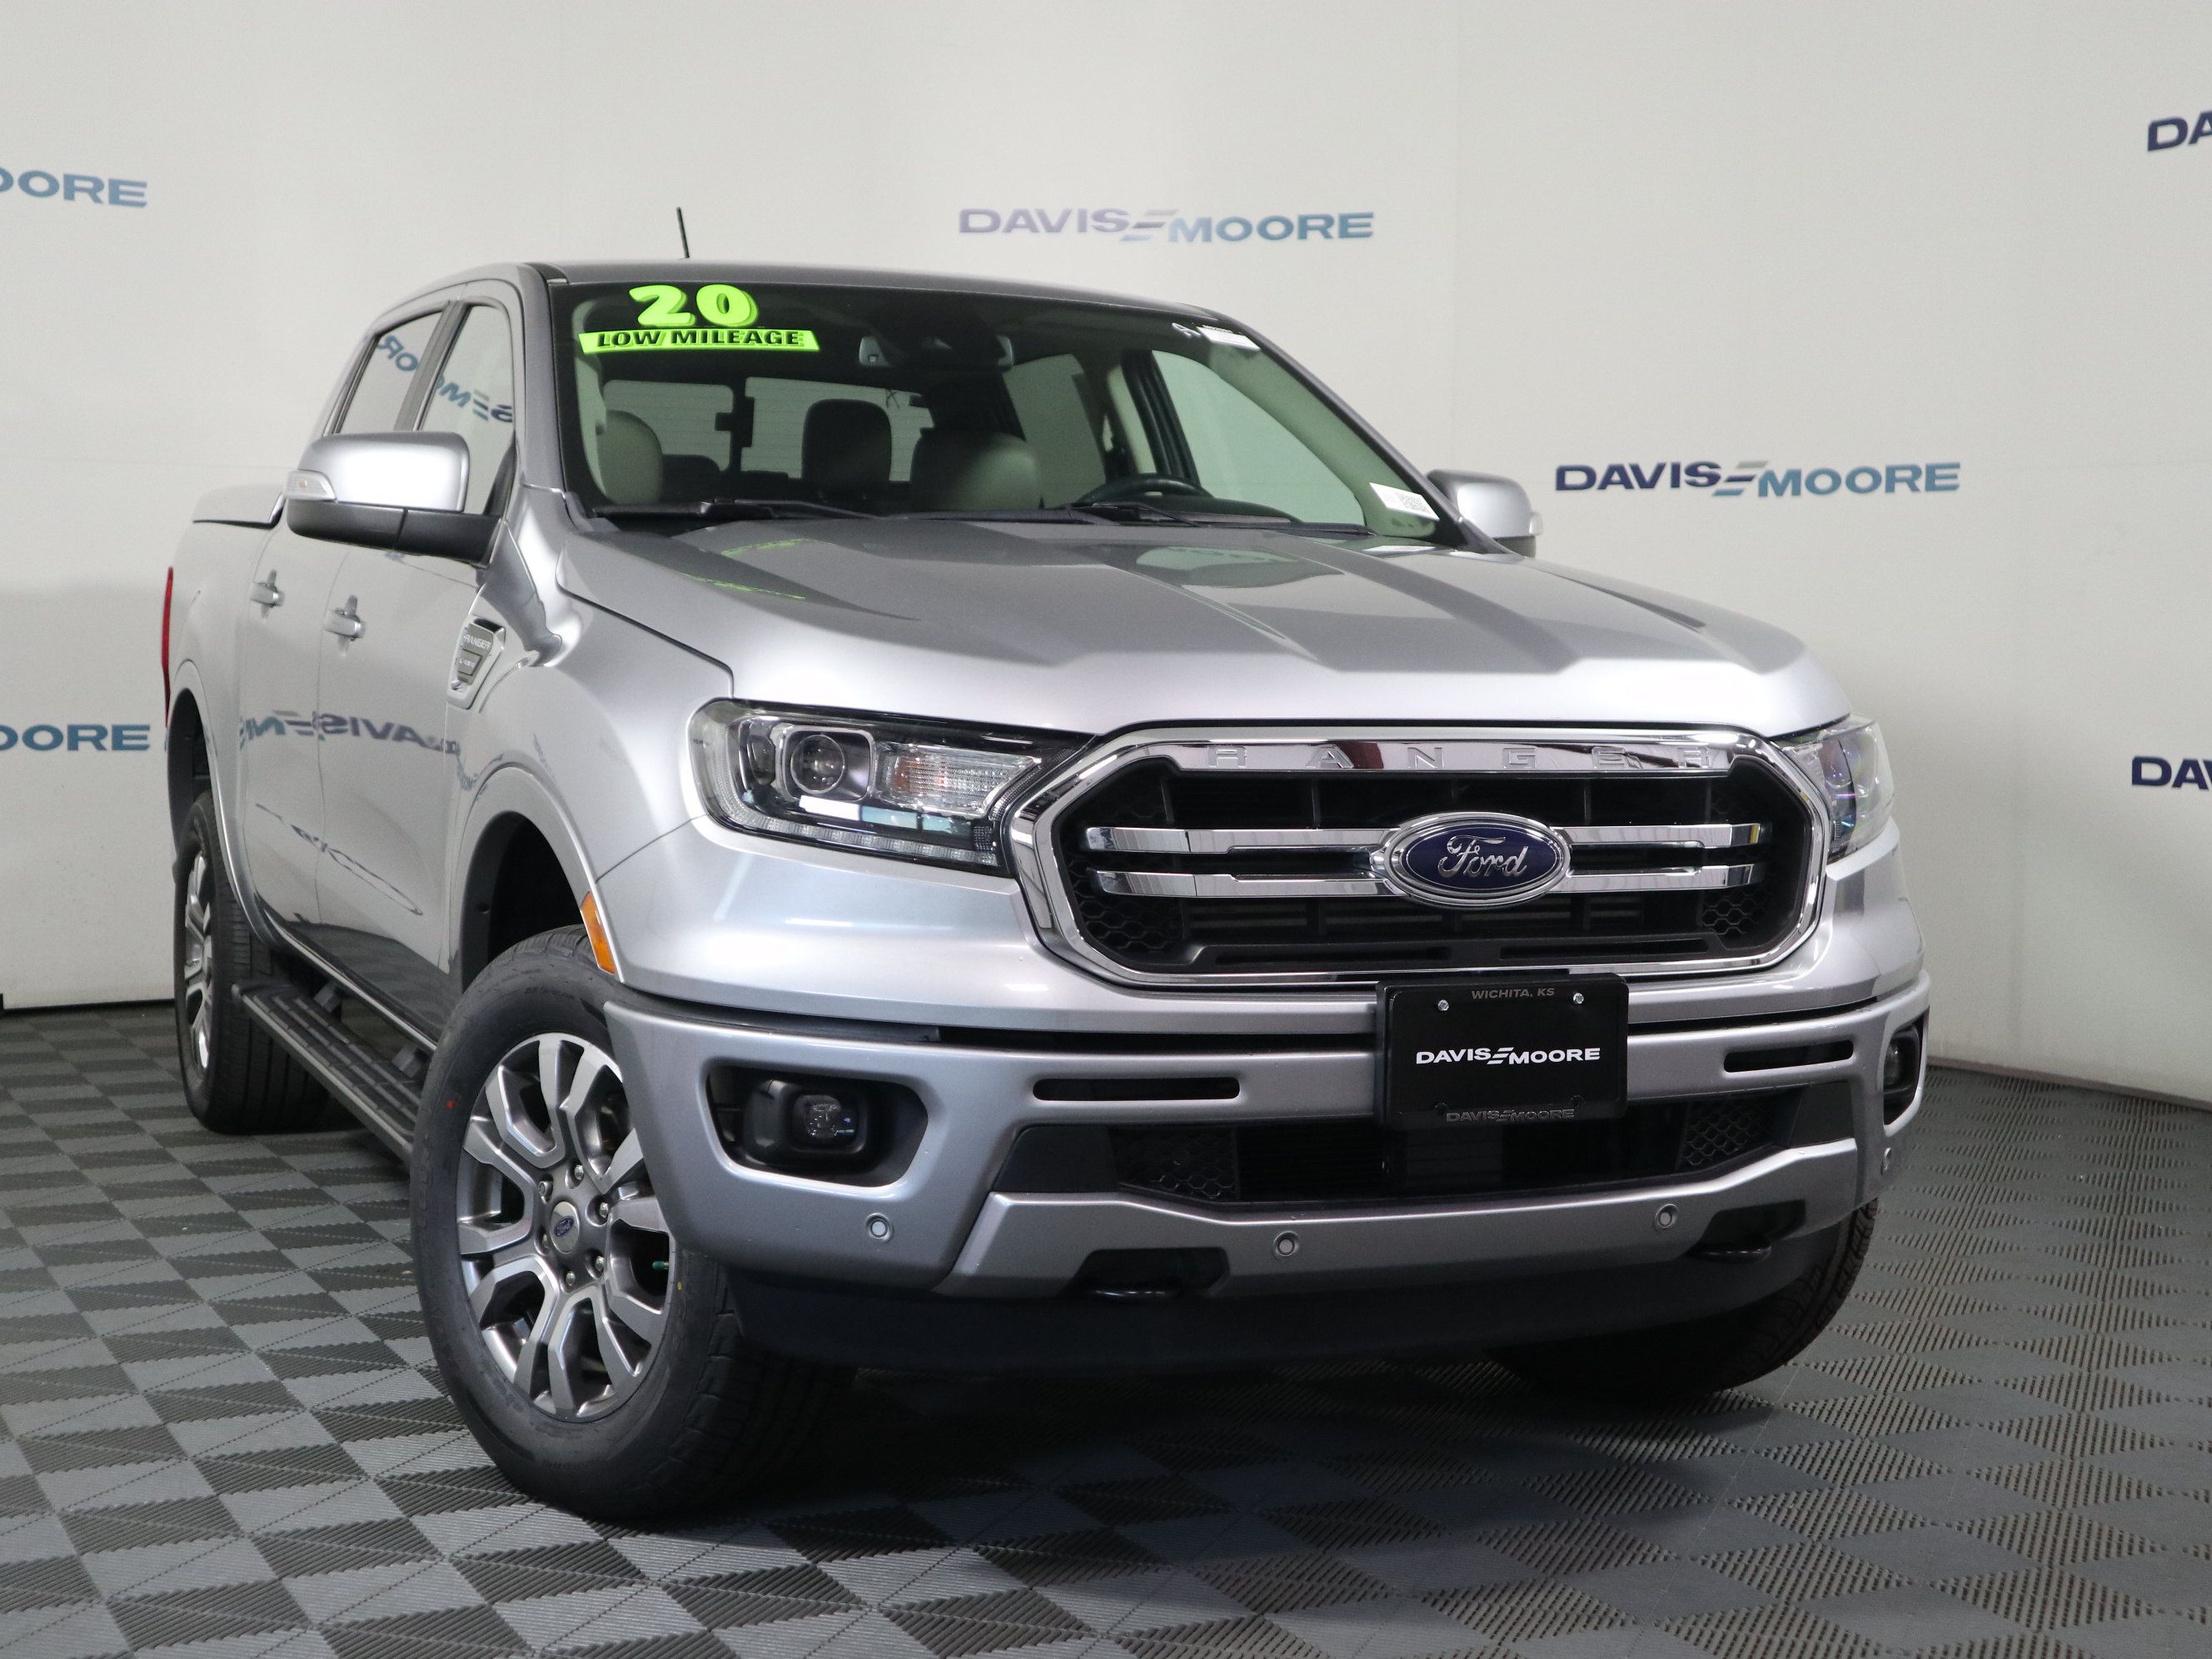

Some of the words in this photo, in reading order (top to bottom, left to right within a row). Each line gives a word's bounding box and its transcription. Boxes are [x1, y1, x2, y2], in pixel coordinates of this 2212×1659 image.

[959, 207, 1129, 233] DAVIS
[1168, 212, 1374, 242] MOORE
[629, 284, 759, 327] 20
[596, 330, 666, 348] LOW
[670, 330, 805, 346] MILEAGE
[1555, 461, 1722, 491] DAVIS
[1757, 462, 1961, 497] MOORE
[1208, 744, 1711, 770] RANGER
[2131, 755, 2212, 790] DA
[1437, 834, 1529, 879] Ford
[1537, 988, 1556, 996] KS
[1416, 1048, 1491, 1064] DAVIS
[1508, 1048, 1601, 1064] MOORE
[1446, 1110, 1499, 1123] DAVIS
[1511, 1108, 1575, 1122] MOORE
